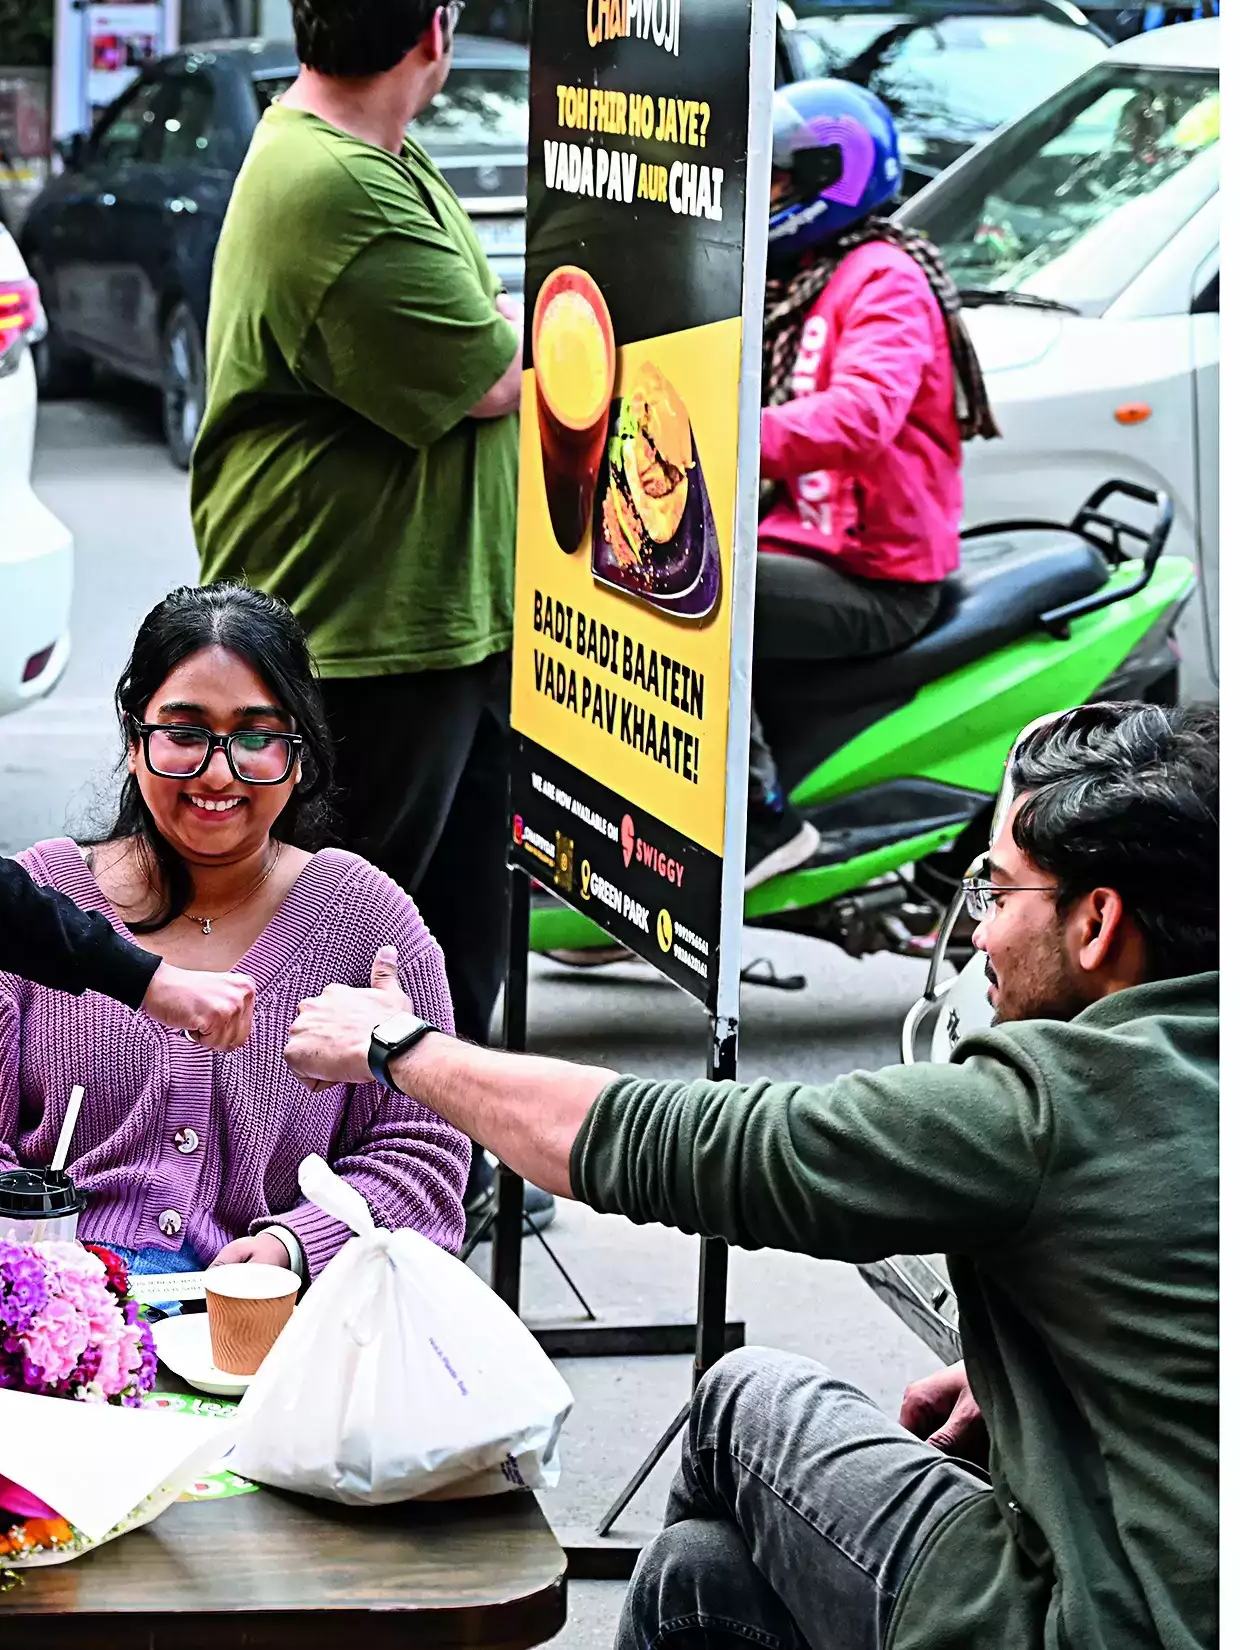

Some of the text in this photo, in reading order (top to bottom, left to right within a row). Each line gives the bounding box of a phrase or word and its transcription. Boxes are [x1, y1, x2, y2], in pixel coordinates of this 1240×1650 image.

[557, 85, 588, 129] TOH
[628, 93, 654, 139] HO
[655, 96, 710, 147] JAYE?
[544, 140, 594, 197] VADA
[596, 149, 637, 203] PAV
[637, 163, 667, 203] AUR
[669, 161, 724, 221] CHAI
[534, 590, 704, 720] BADI BADI BAATEIN
[534, 649, 699, 785] VADA PAV KHAATE!
[532, 772, 619, 843] WE ARE NOW AVAILABLE ON
[635, 838, 684, 888] SWIGGY
[590, 872, 650, 933] GREEN PARK
